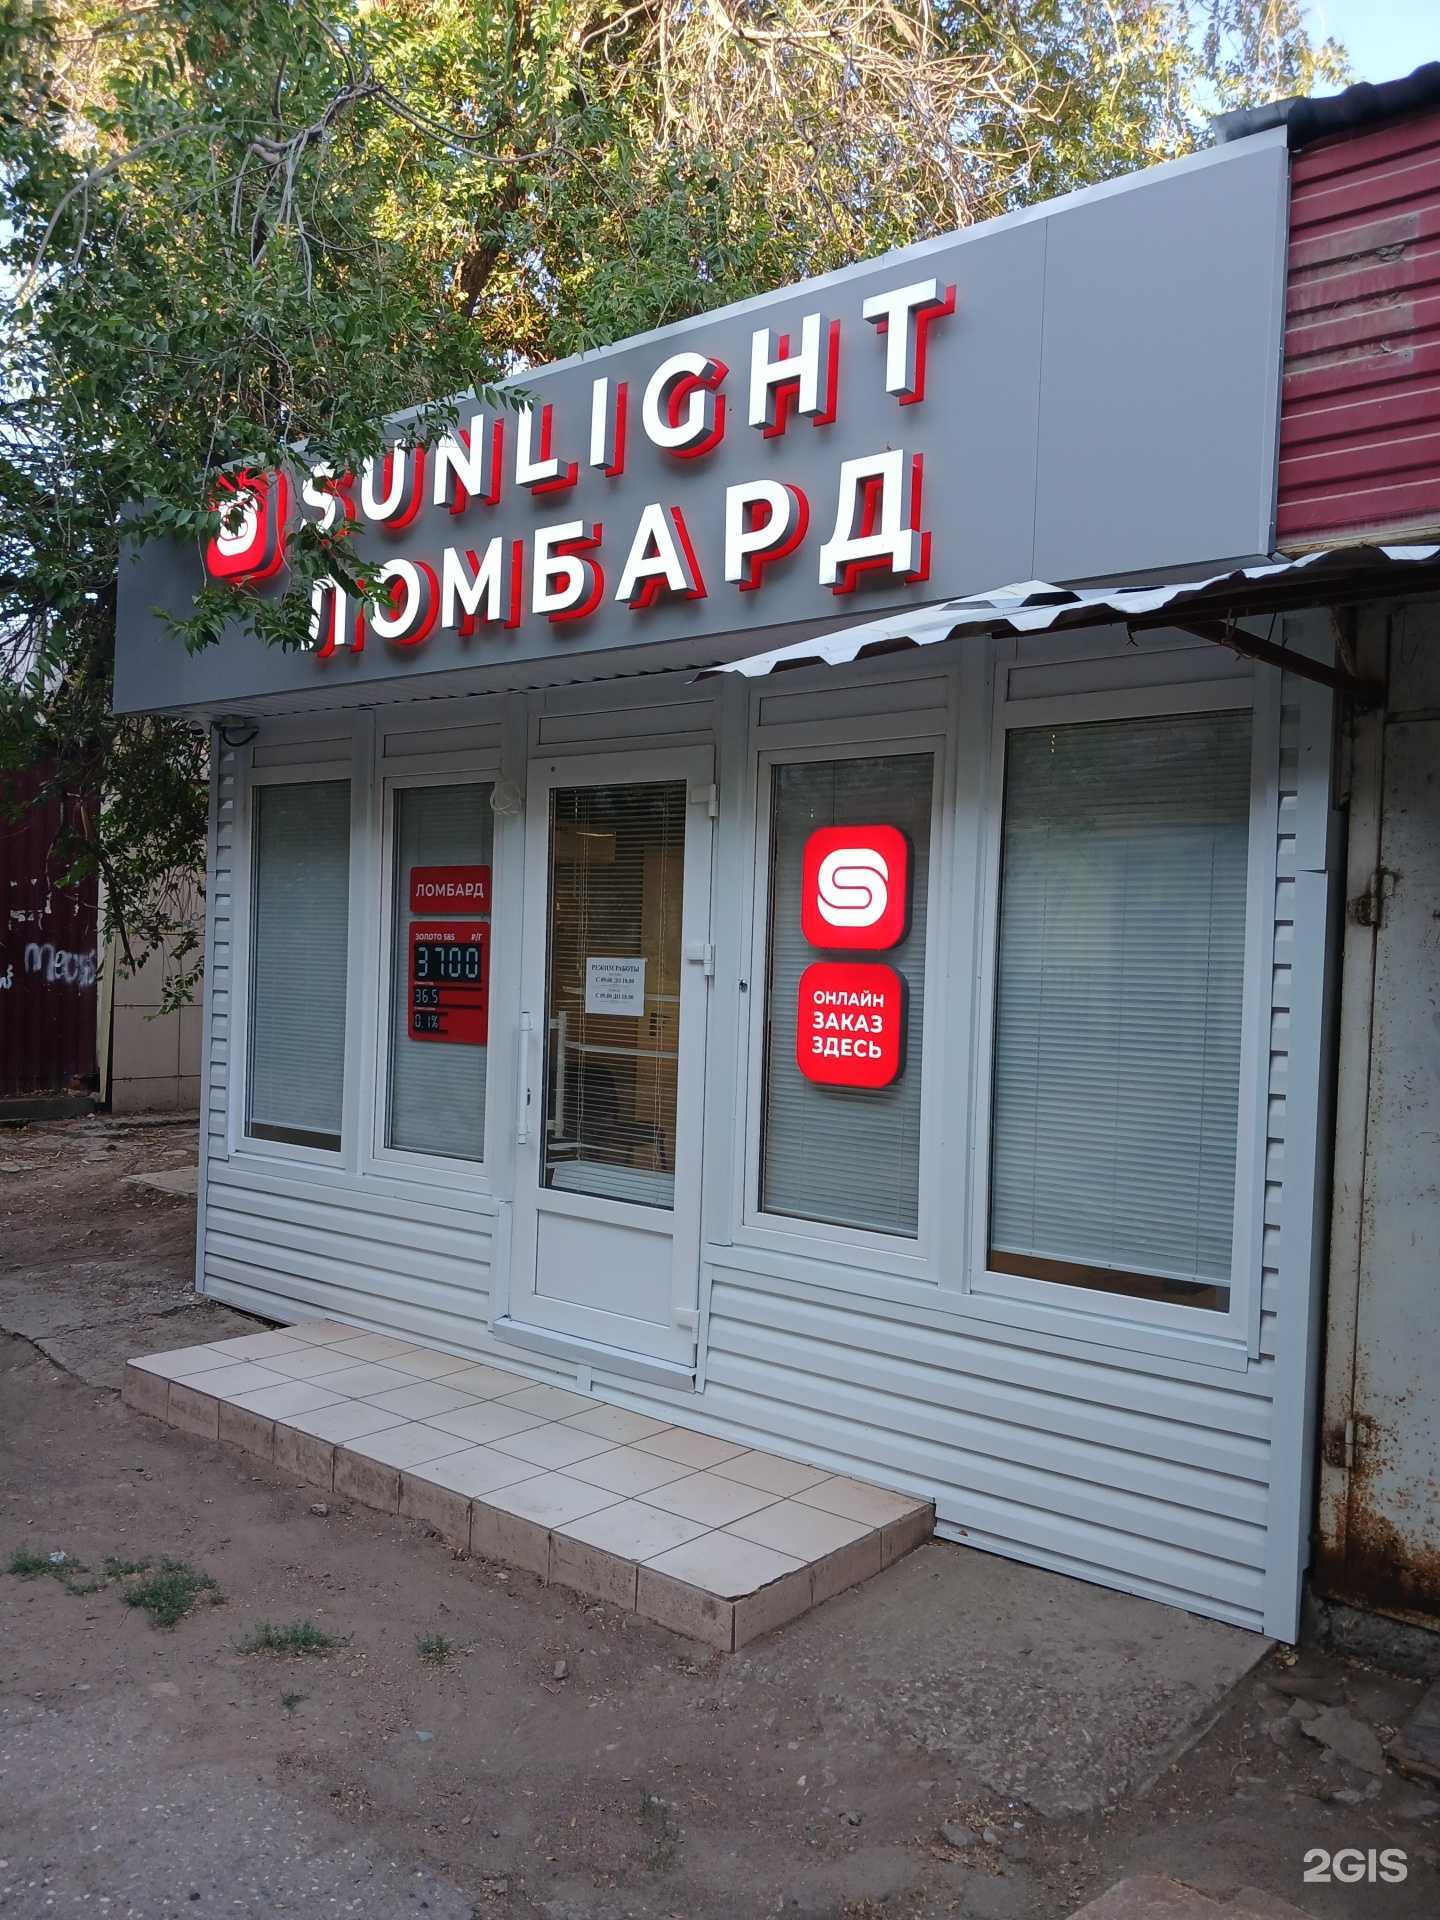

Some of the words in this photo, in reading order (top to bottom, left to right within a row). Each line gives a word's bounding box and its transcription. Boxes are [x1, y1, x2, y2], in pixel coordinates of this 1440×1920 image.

[301, 278, 946, 534] SUNLIGHT
[301, 449, 922, 652] ЛОМБАРД
[415, 882, 484, 899] ЛОМБАРД
[415, 932, 442, 941] ЗОЛОТО
[418, 946, 479, 978] 3700
[812, 989, 884, 1008] ОНЛАЙН
[811, 1011, 884, 1034] ЗАКАЗ
[811, 1035, 882, 1060] ЗДЕСЬ
